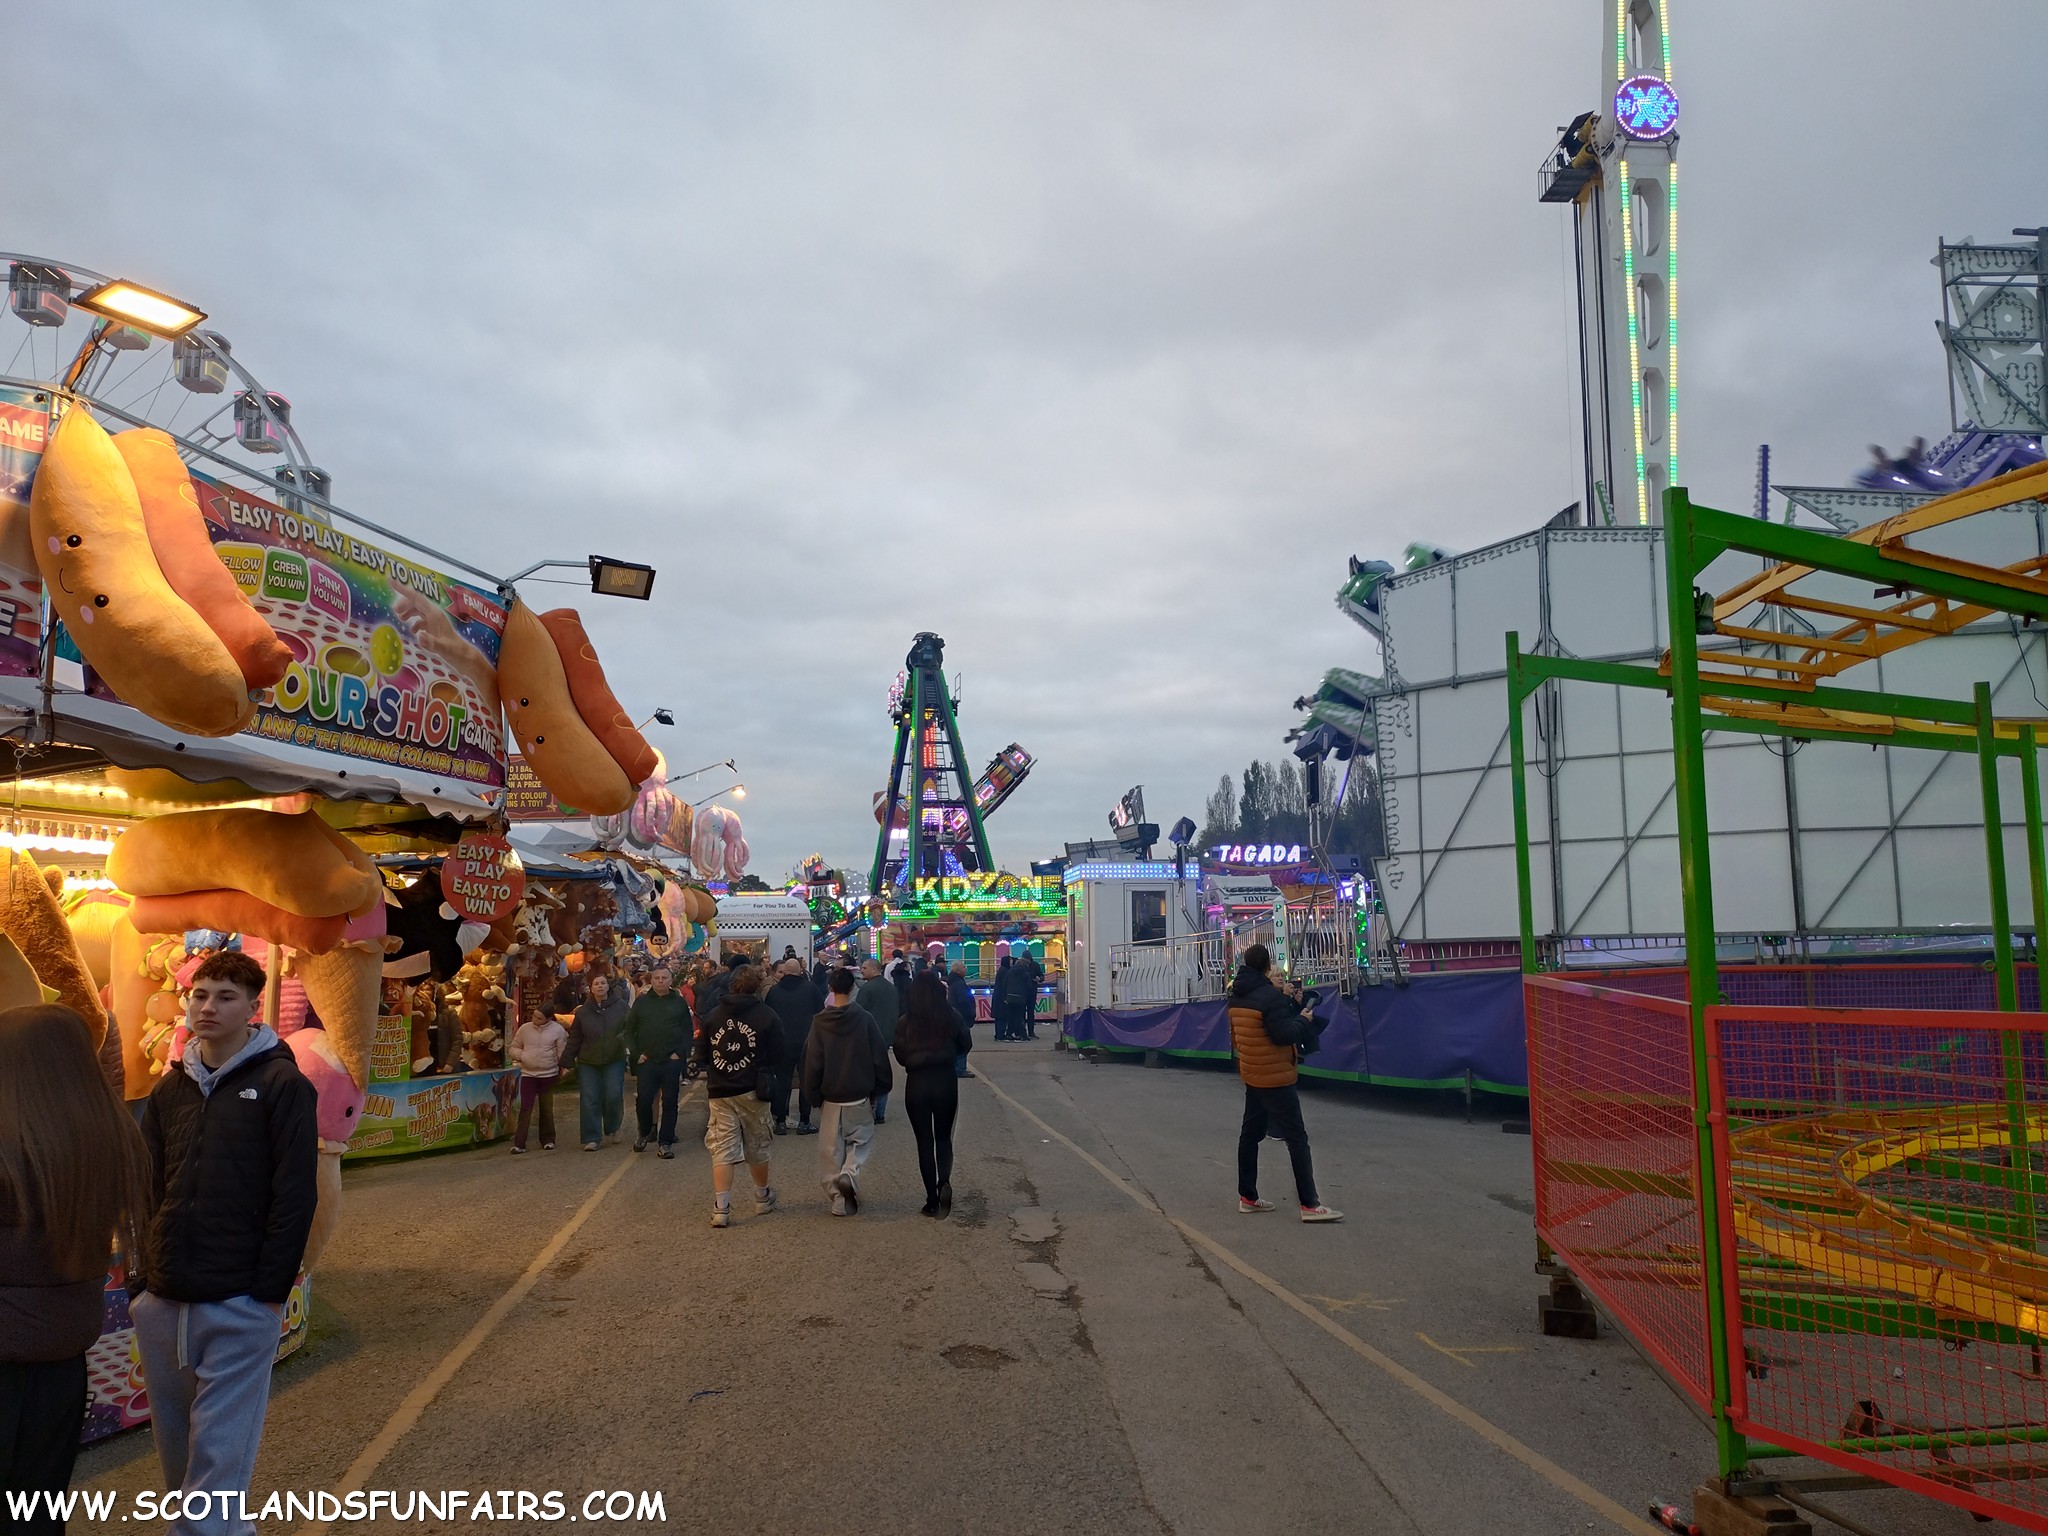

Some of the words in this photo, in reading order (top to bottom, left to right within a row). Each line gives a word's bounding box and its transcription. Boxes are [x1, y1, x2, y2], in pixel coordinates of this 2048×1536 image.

[229, 500, 272, 531] EASY
[275, 513, 298, 539] TO
[302, 522, 349, 560] PLAY,
[350, 539, 386, 573] EASY
[388, 557, 408, 584] TO
[409, 569, 440, 600] WIN
[272, 560, 303, 576] GREEN
[237, 573, 258, 586] WIN
[268, 574, 287, 589] YOU
[288, 577, 306, 591] WIN
[317, 572, 342, 596] PINK
[313, 585, 330, 602] YOU
[330, 595, 346, 612] WIN
[463, 593, 489, 618] FAMILY
[374, 684, 466, 751] SHOT
[464, 721, 498, 760] GAME
[259, 713, 296, 742] ANY
[295, 725, 314, 745] OF
[314, 729, 340, 751] THE
[339, 731, 400, 763] WINNING
[400, 744, 452, 773] COLOURS
[452, 757, 465, 777] TO
[508, 773, 533, 781] COLOUR
[520, 792, 548, 800] COLOUR
[527, 800, 543, 808] TOY!
[457, 844, 494, 863] EASY
[1220, 845, 1300, 862] TAGADA
[465, 861, 506, 881] PLAY
[452, 878, 489, 900] EASY
[491, 885, 511, 901] TO
[465, 898, 496, 916] WIN
[377, 1015, 402, 1029] EVERY
[710, 1027, 726, 1046] Los
[371, 1043, 398, 1057] WINS
[399, 1042, 408, 1055] A
[726, 1042, 741, 1051] 349
[375, 1066, 401, 1078] COW
[407, 1089, 431, 1107] EVERY
[432, 1079, 461, 1098] PLAYER
[416, 1099, 442, 1118] WINS
[444, 1092, 452, 1107] A
[407, 1105, 460, 1137] HIGHLAND
[364, 1129, 393, 1148] COW
[421, 1123, 447, 1149] COW
